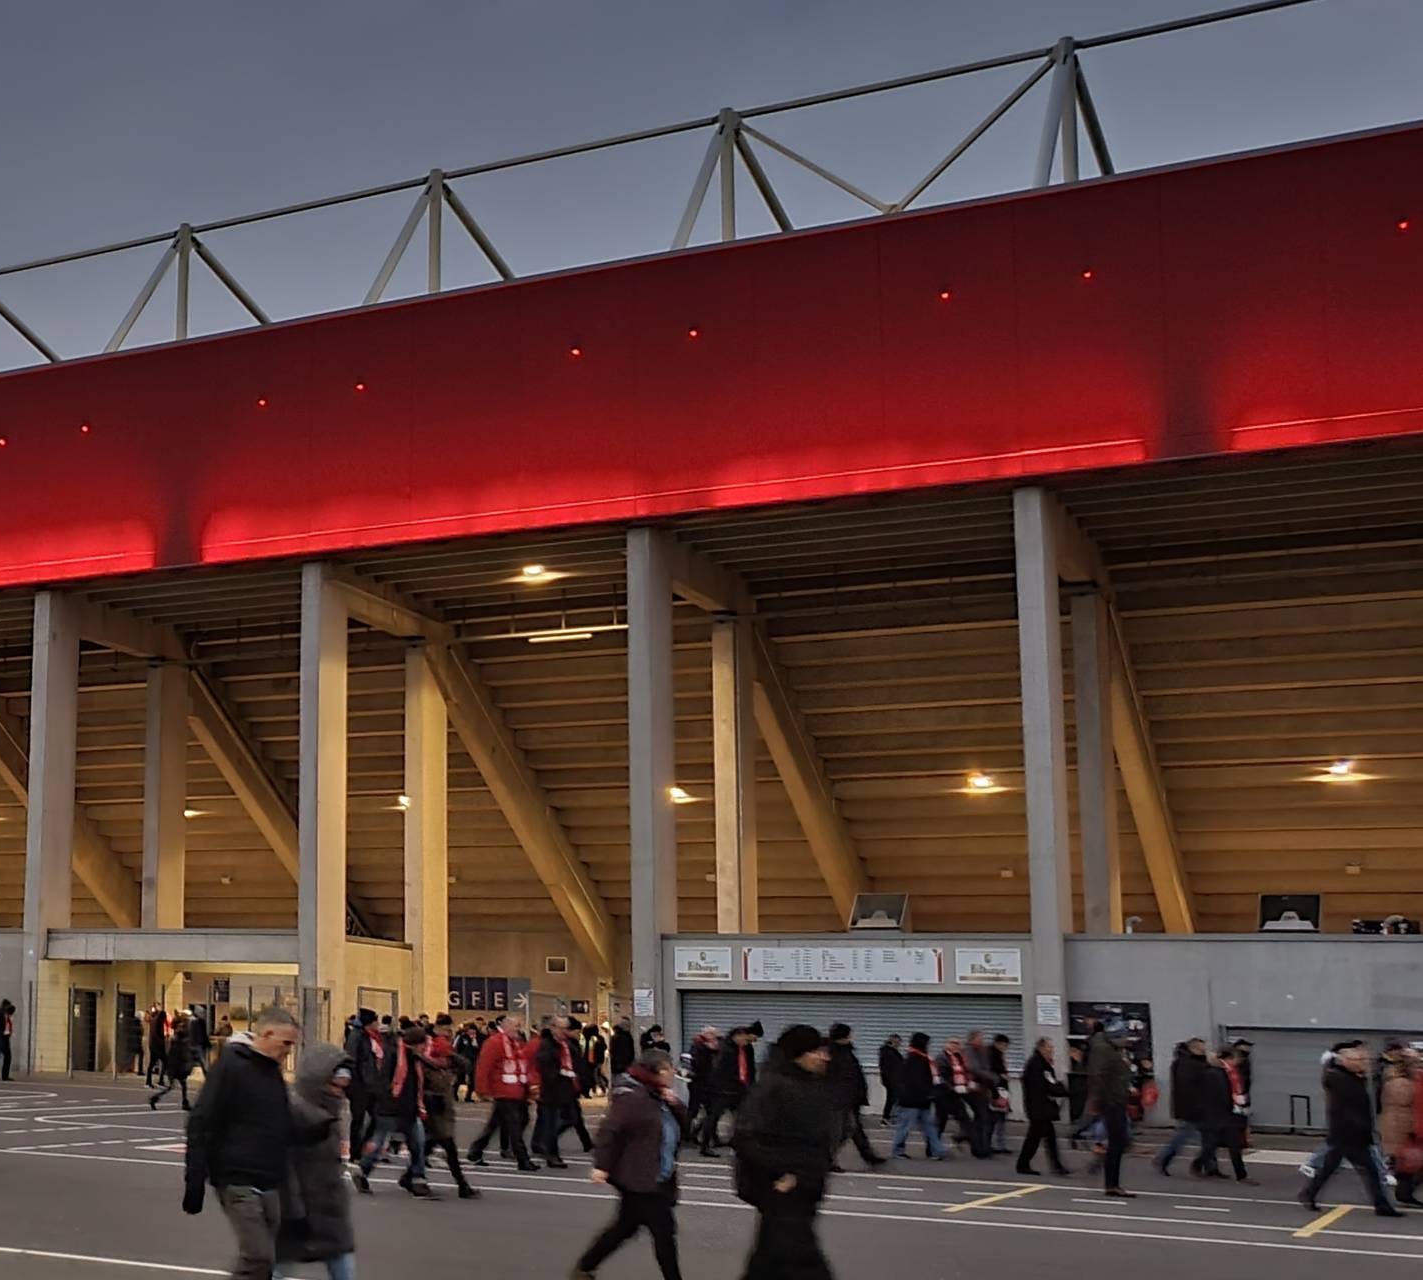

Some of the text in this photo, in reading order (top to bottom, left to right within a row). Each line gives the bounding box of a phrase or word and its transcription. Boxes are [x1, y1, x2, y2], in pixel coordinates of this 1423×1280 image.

[448, 990, 505, 1008] G F E
